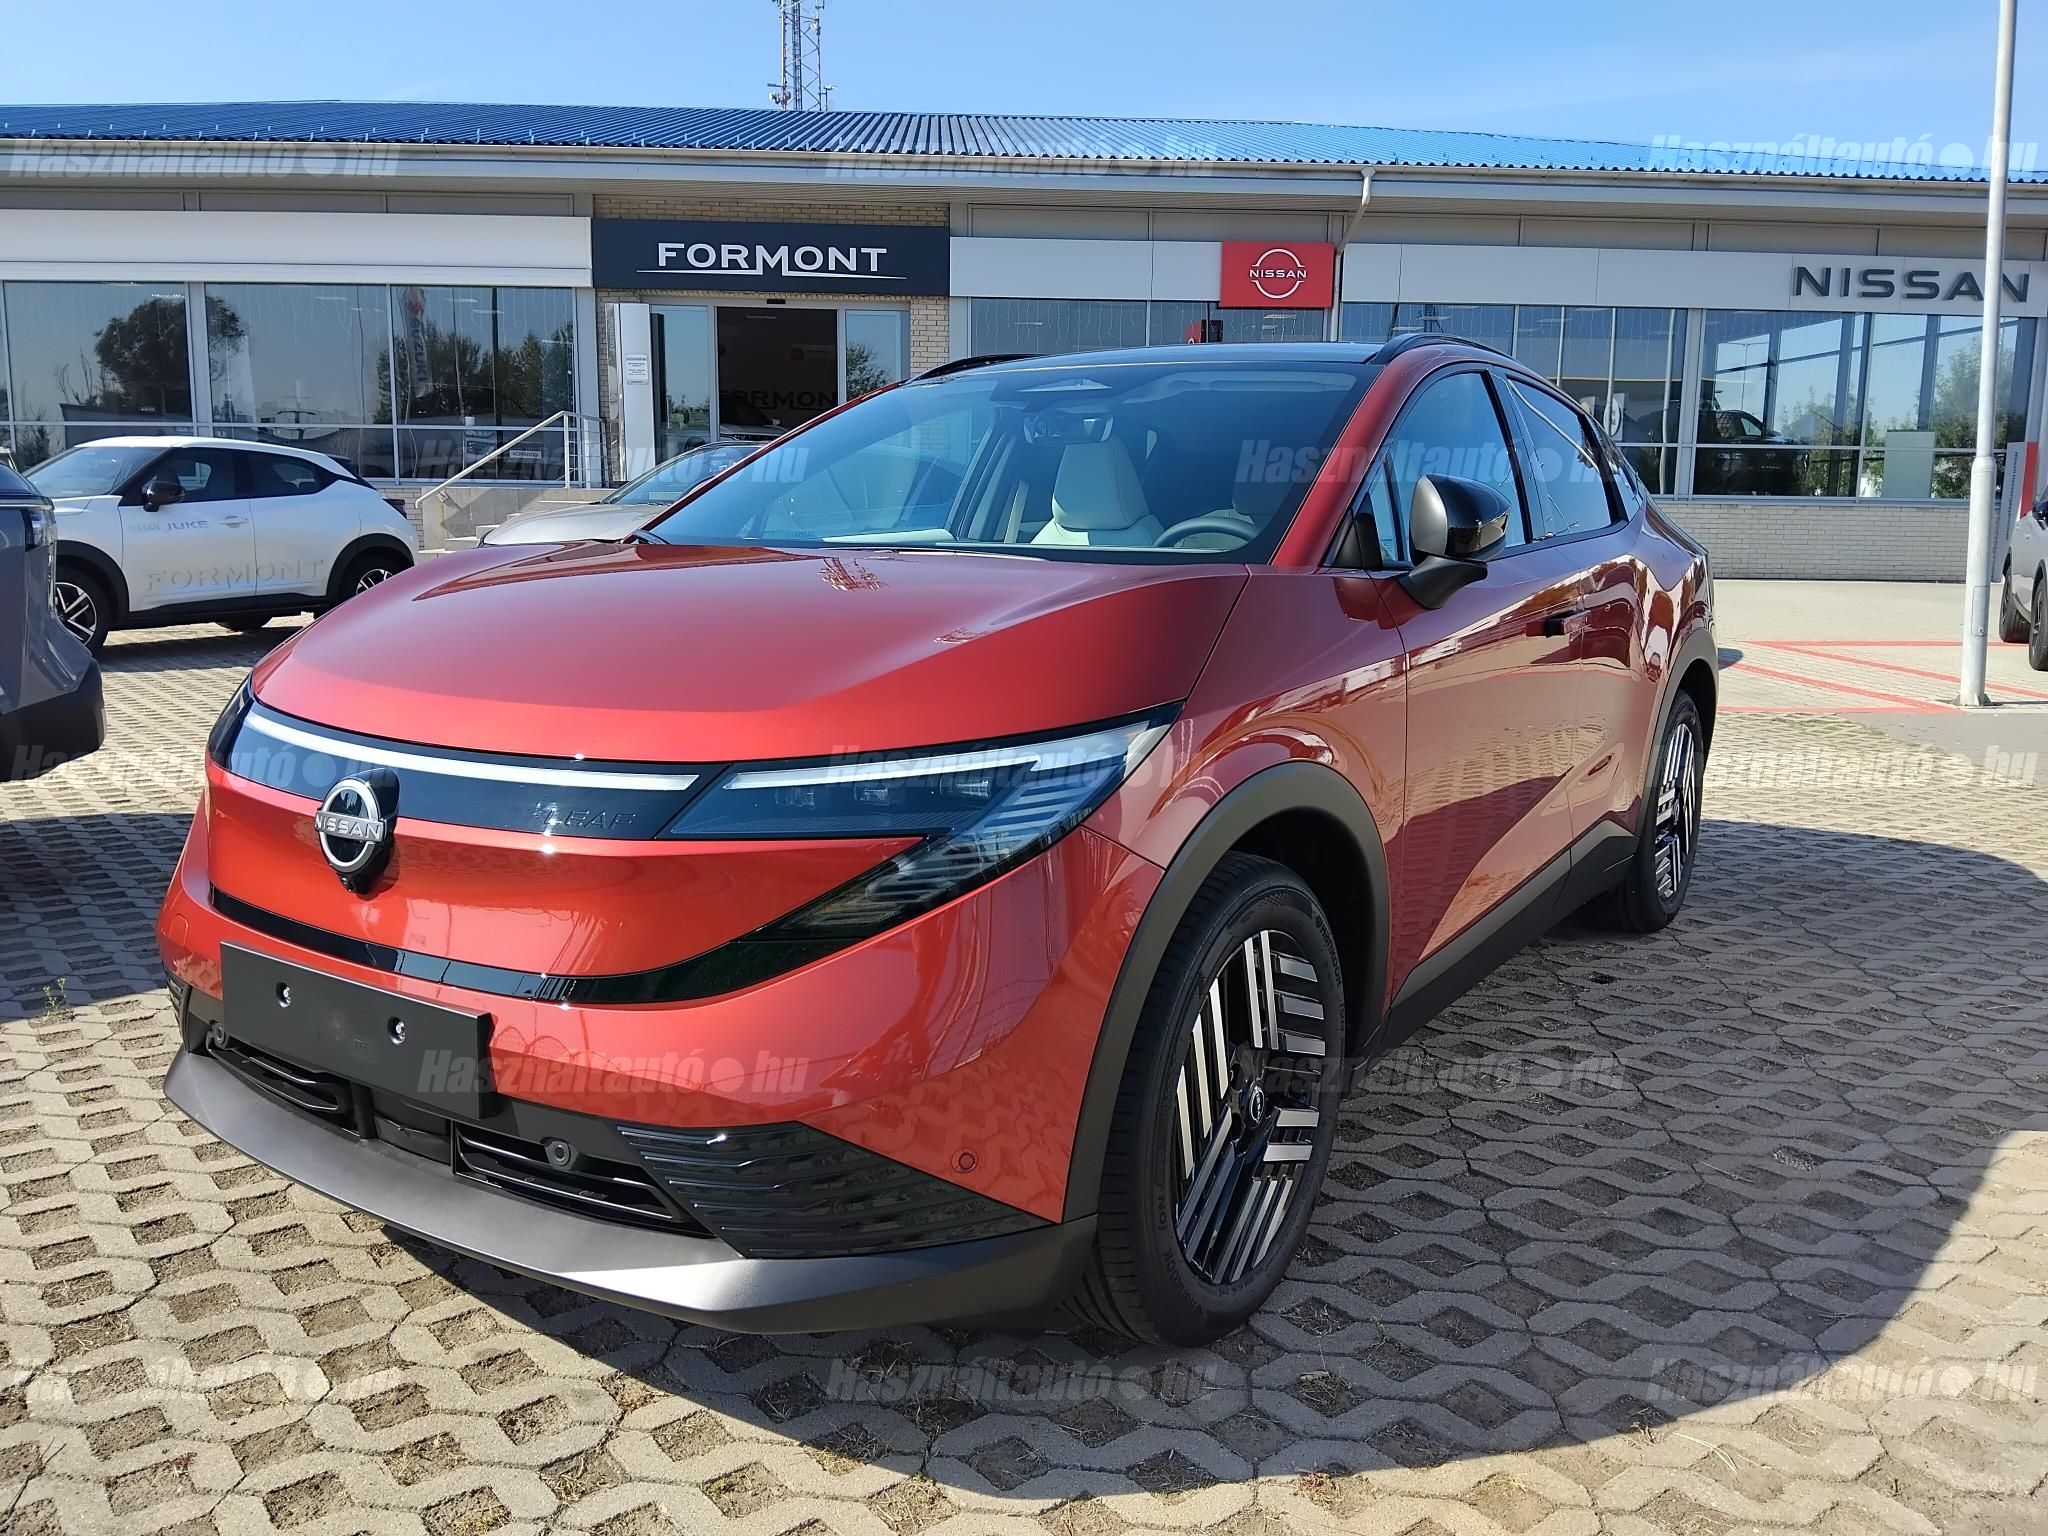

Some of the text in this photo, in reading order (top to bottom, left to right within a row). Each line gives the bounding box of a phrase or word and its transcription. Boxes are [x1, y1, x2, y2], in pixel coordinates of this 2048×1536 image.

[658, 242, 888, 275] FORMONT
[1250, 269, 1307, 279] NISSAN
[1793, 266, 2030, 303] NISSAN
[166, 520, 208, 533] JUKE
[149, 560, 324, 592] FORMONT
[315, 813, 383, 842] NISSAN
